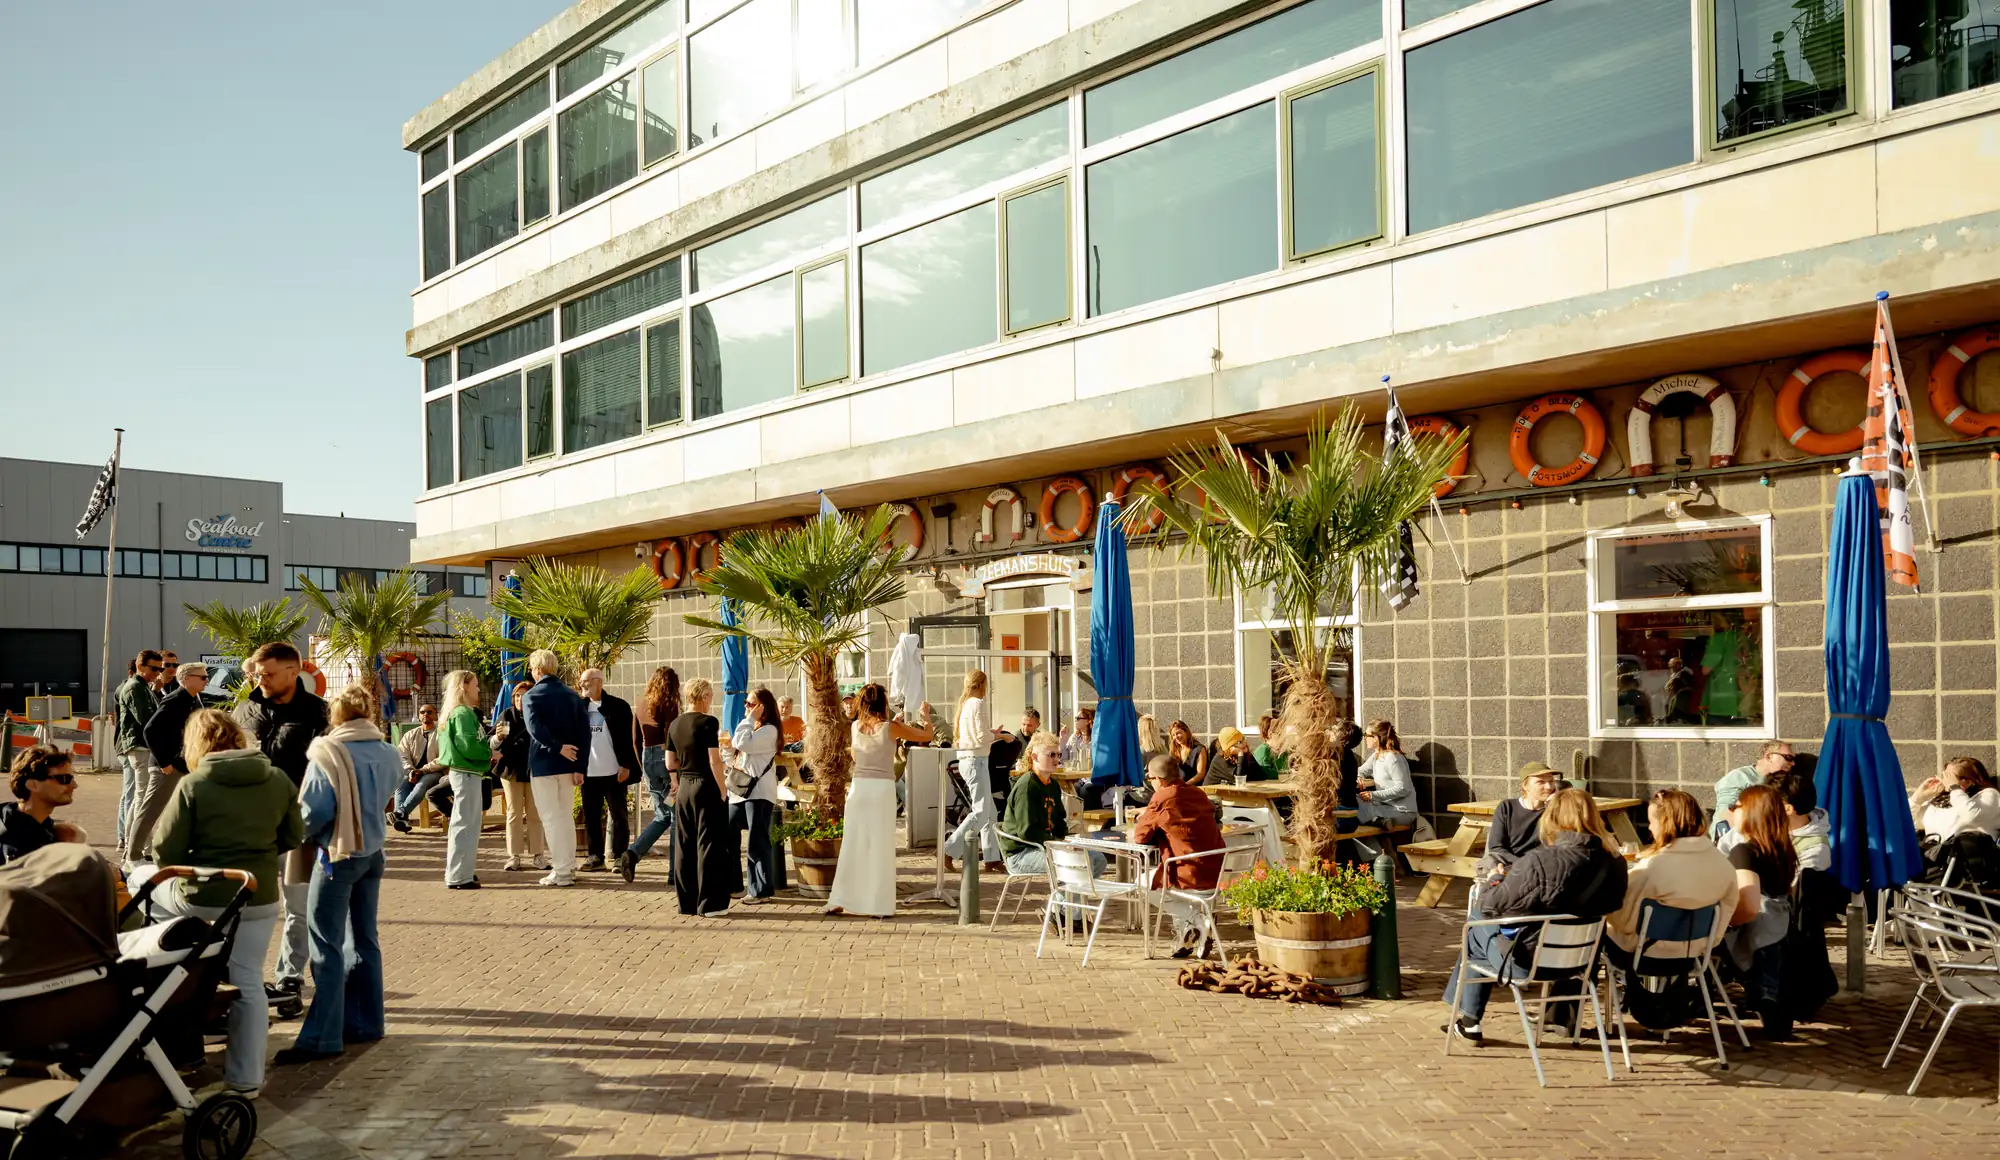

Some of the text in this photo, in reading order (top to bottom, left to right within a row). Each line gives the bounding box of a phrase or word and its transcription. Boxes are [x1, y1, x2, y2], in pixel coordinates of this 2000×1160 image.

[185, 516, 264, 541] Seafood
[199, 534, 253, 549] Centre
[982, 555, 1073, 580] ZEEMANSHUIS
